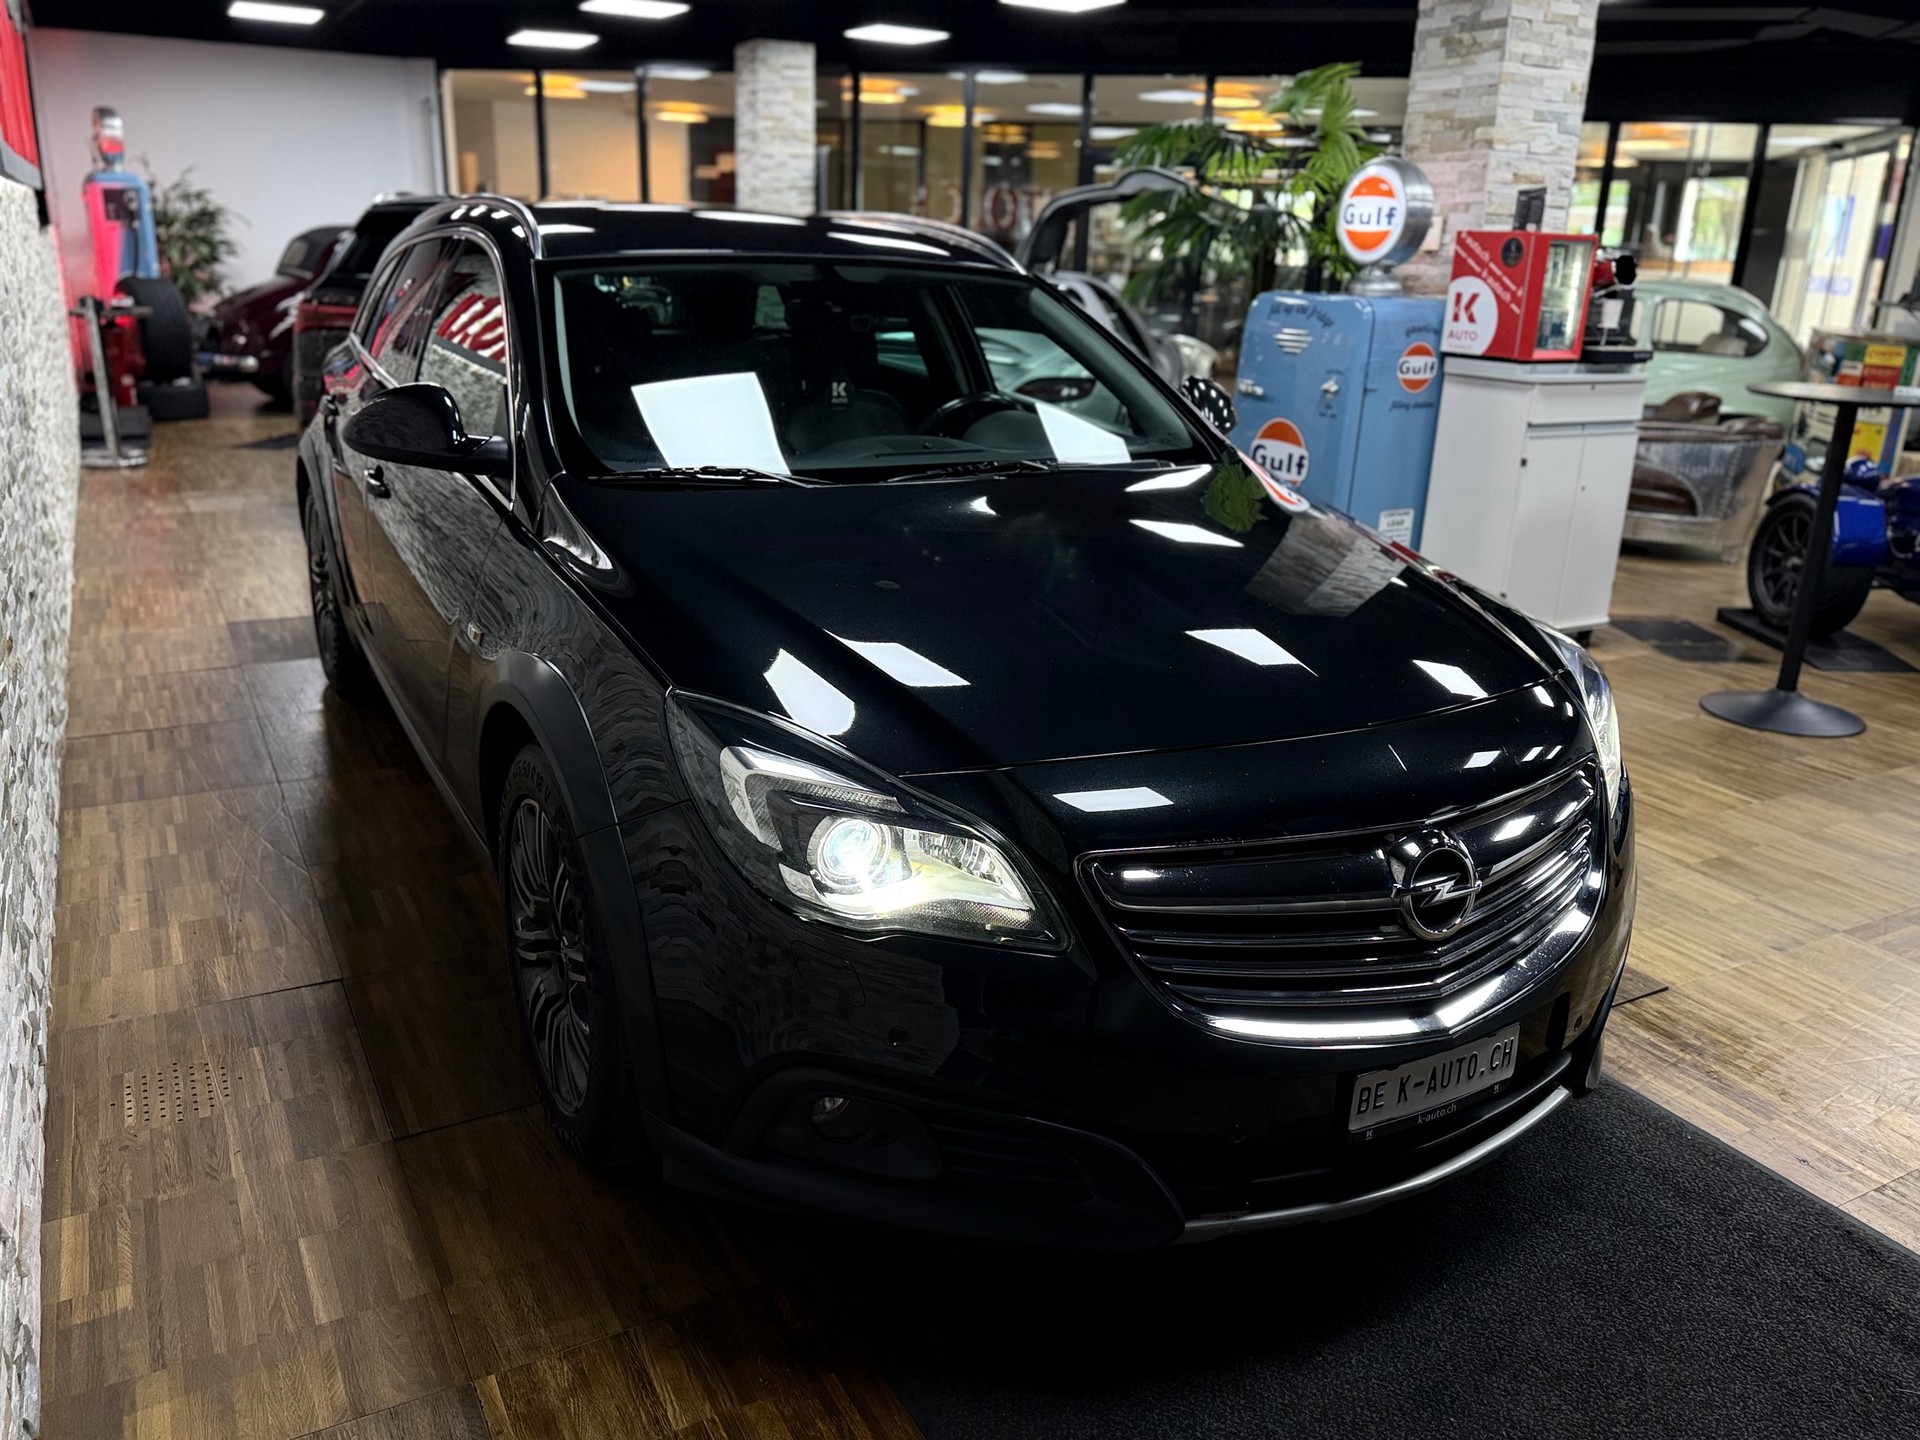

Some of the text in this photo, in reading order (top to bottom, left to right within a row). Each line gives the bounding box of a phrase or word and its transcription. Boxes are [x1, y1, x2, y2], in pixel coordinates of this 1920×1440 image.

[1343, 203, 1398, 226] Gulf
[1452, 291, 1481, 324] K
[1446, 329, 1478, 341] AUTO
[1398, 360, 1437, 375] Gulf
[831, 381, 848, 397] K
[1252, 444, 1307, 475] Gulf
[1356, 1037, 1515, 1115] BE K-AUTO.CH
[1418, 1104, 1458, 1125] k-auto.ch
